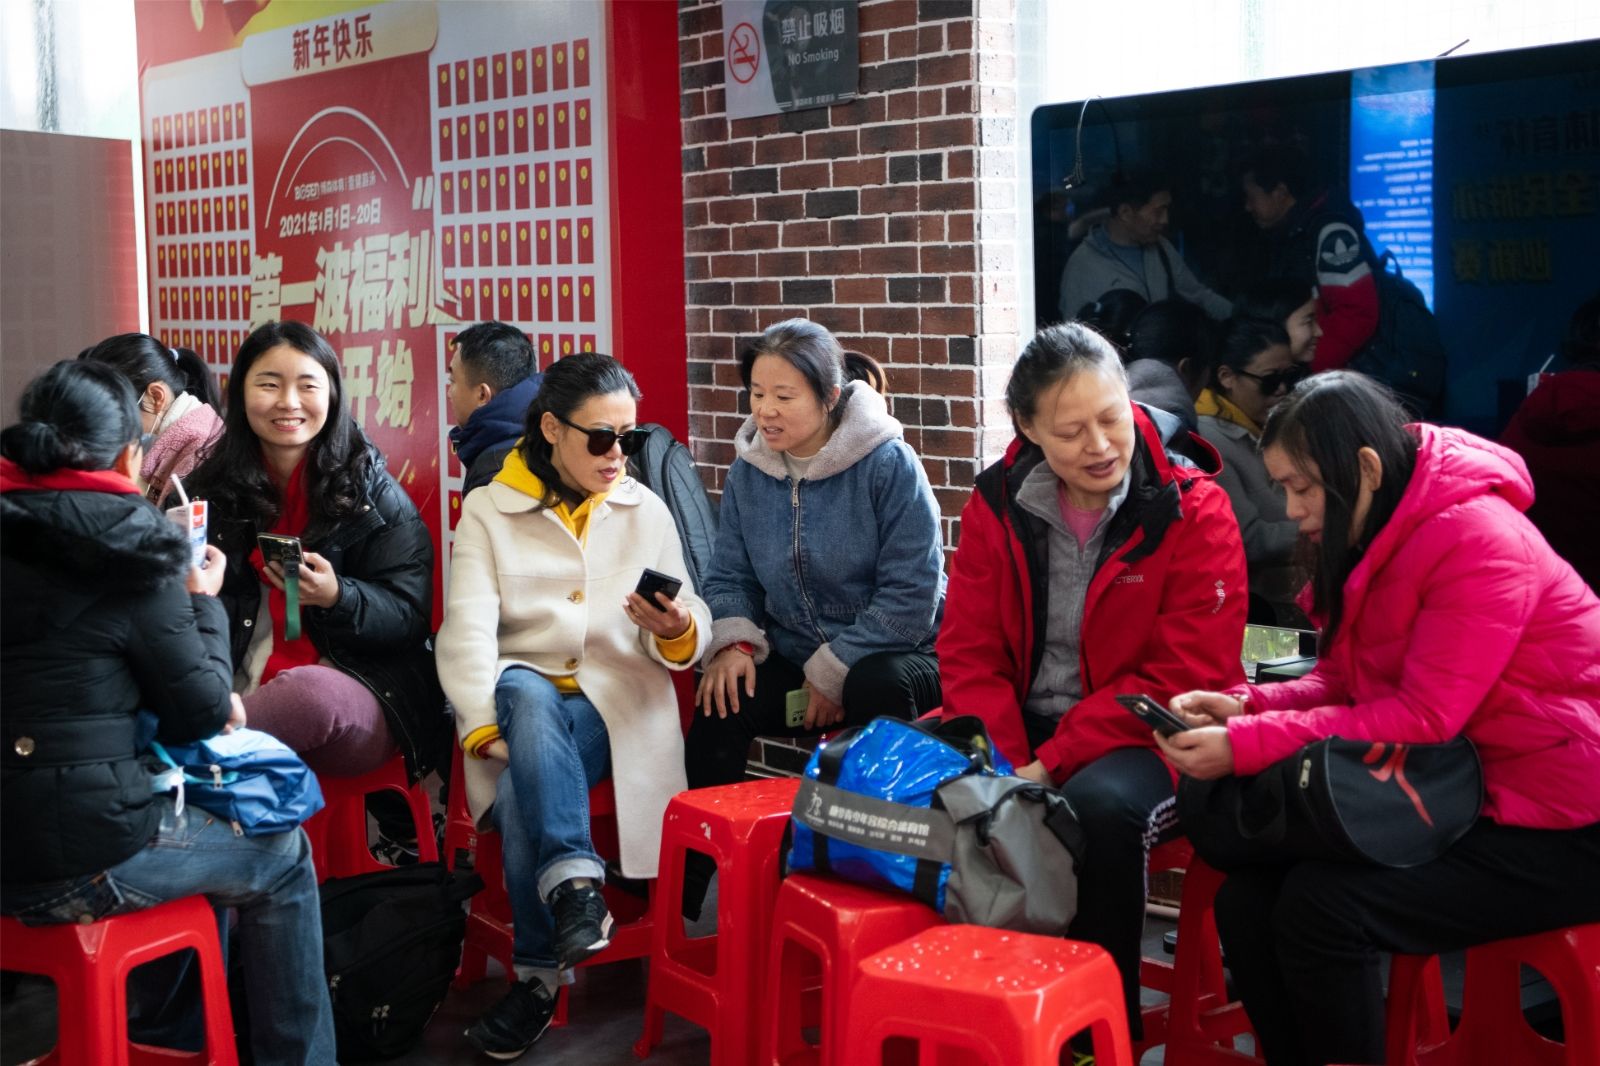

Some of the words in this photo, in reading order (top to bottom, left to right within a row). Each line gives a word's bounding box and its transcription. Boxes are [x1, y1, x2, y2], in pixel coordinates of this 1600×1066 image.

[292, 13, 373, 71] 新年快乐
[782, 8, 845, 44] 禁止吸烟
[788, 54, 801, 66] NO
[802, 49, 839, 64] Smoking
[279, 197, 381, 238] 2021年1月1日-20日
[250, 229, 430, 336] 第一波福利
[342, 338, 414, 429] 开始
